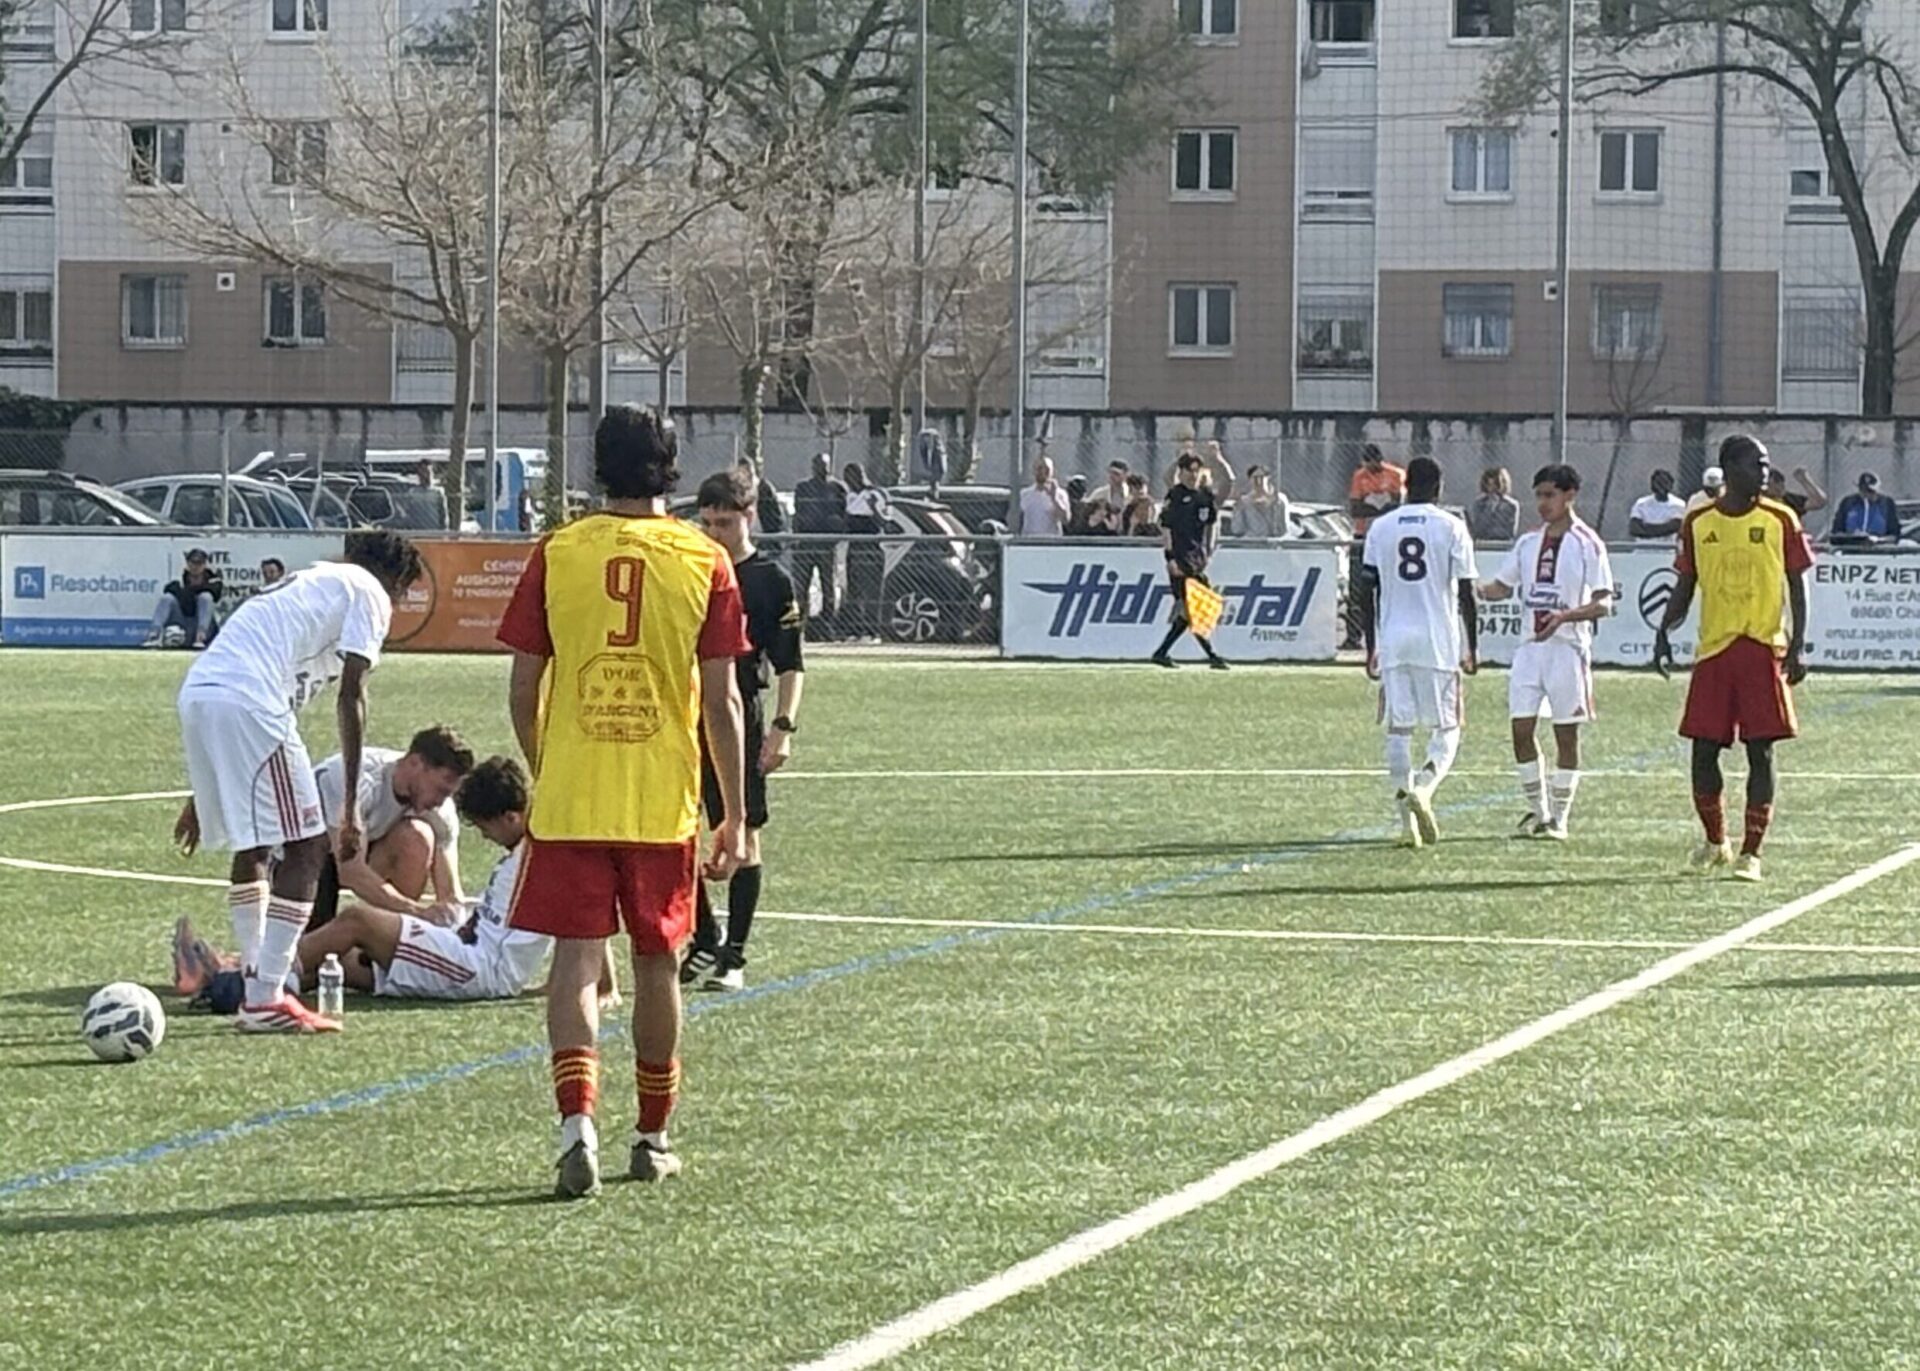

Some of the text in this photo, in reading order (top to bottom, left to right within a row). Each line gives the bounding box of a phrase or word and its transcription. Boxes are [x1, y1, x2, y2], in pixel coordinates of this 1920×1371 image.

[1398, 536, 1428, 581] 8
[1815, 565, 1878, 584] ENPZ
[51, 575, 159, 594] Resotainer
[604, 556, 645, 647] 9
[1021, 563, 1321, 637] Hidrtal
